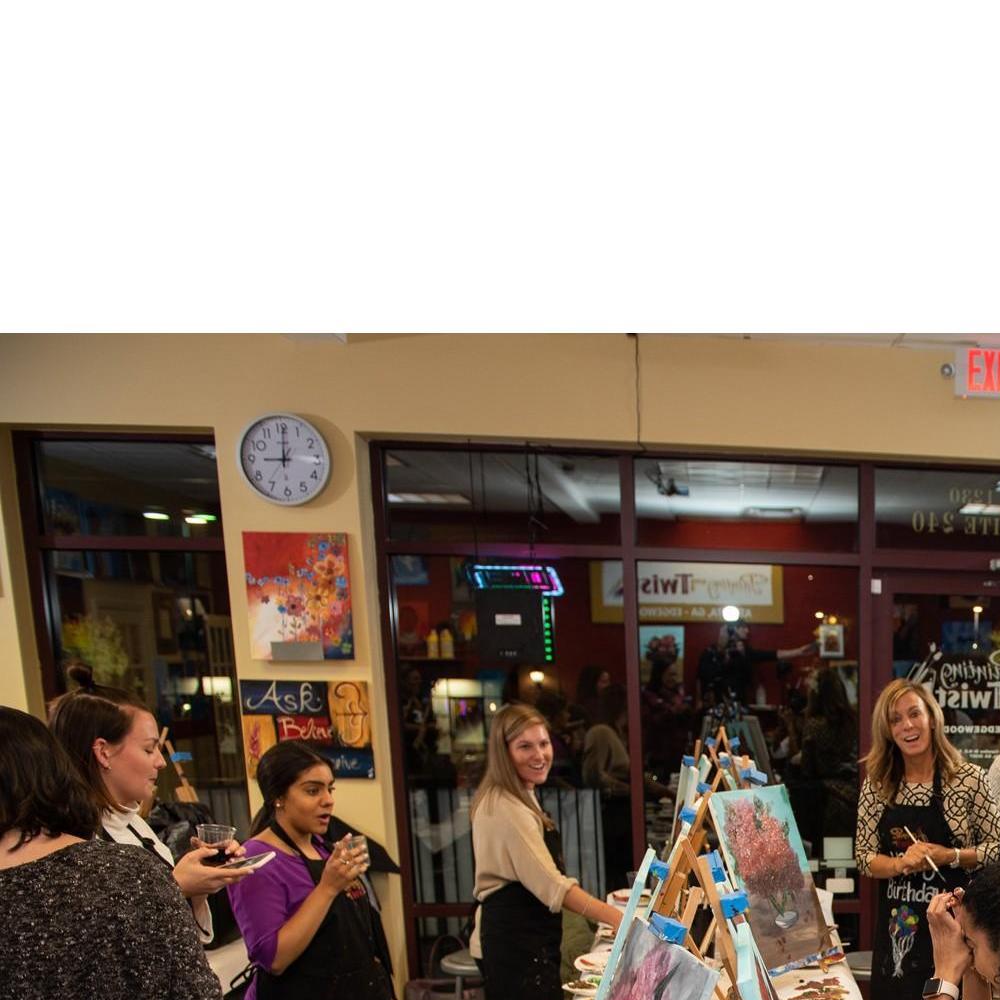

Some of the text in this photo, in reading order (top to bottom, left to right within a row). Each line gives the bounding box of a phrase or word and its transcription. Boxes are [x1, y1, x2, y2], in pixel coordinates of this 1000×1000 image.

[262, 427, 271, 439] 11
[251, 440, 266, 451] 10
[307, 438, 314, 449] 2
[248, 454, 255, 463] 9
[313, 454, 321, 465] 3
[255, 470, 263, 481] 8
[310, 470, 318, 480] 4
[268, 481, 276, 491] 7
[284, 486, 292, 496] 6
[300, 481, 308, 492] 5
[246, 680, 322, 715] Ask
[887, 878, 940, 903] Birthda
